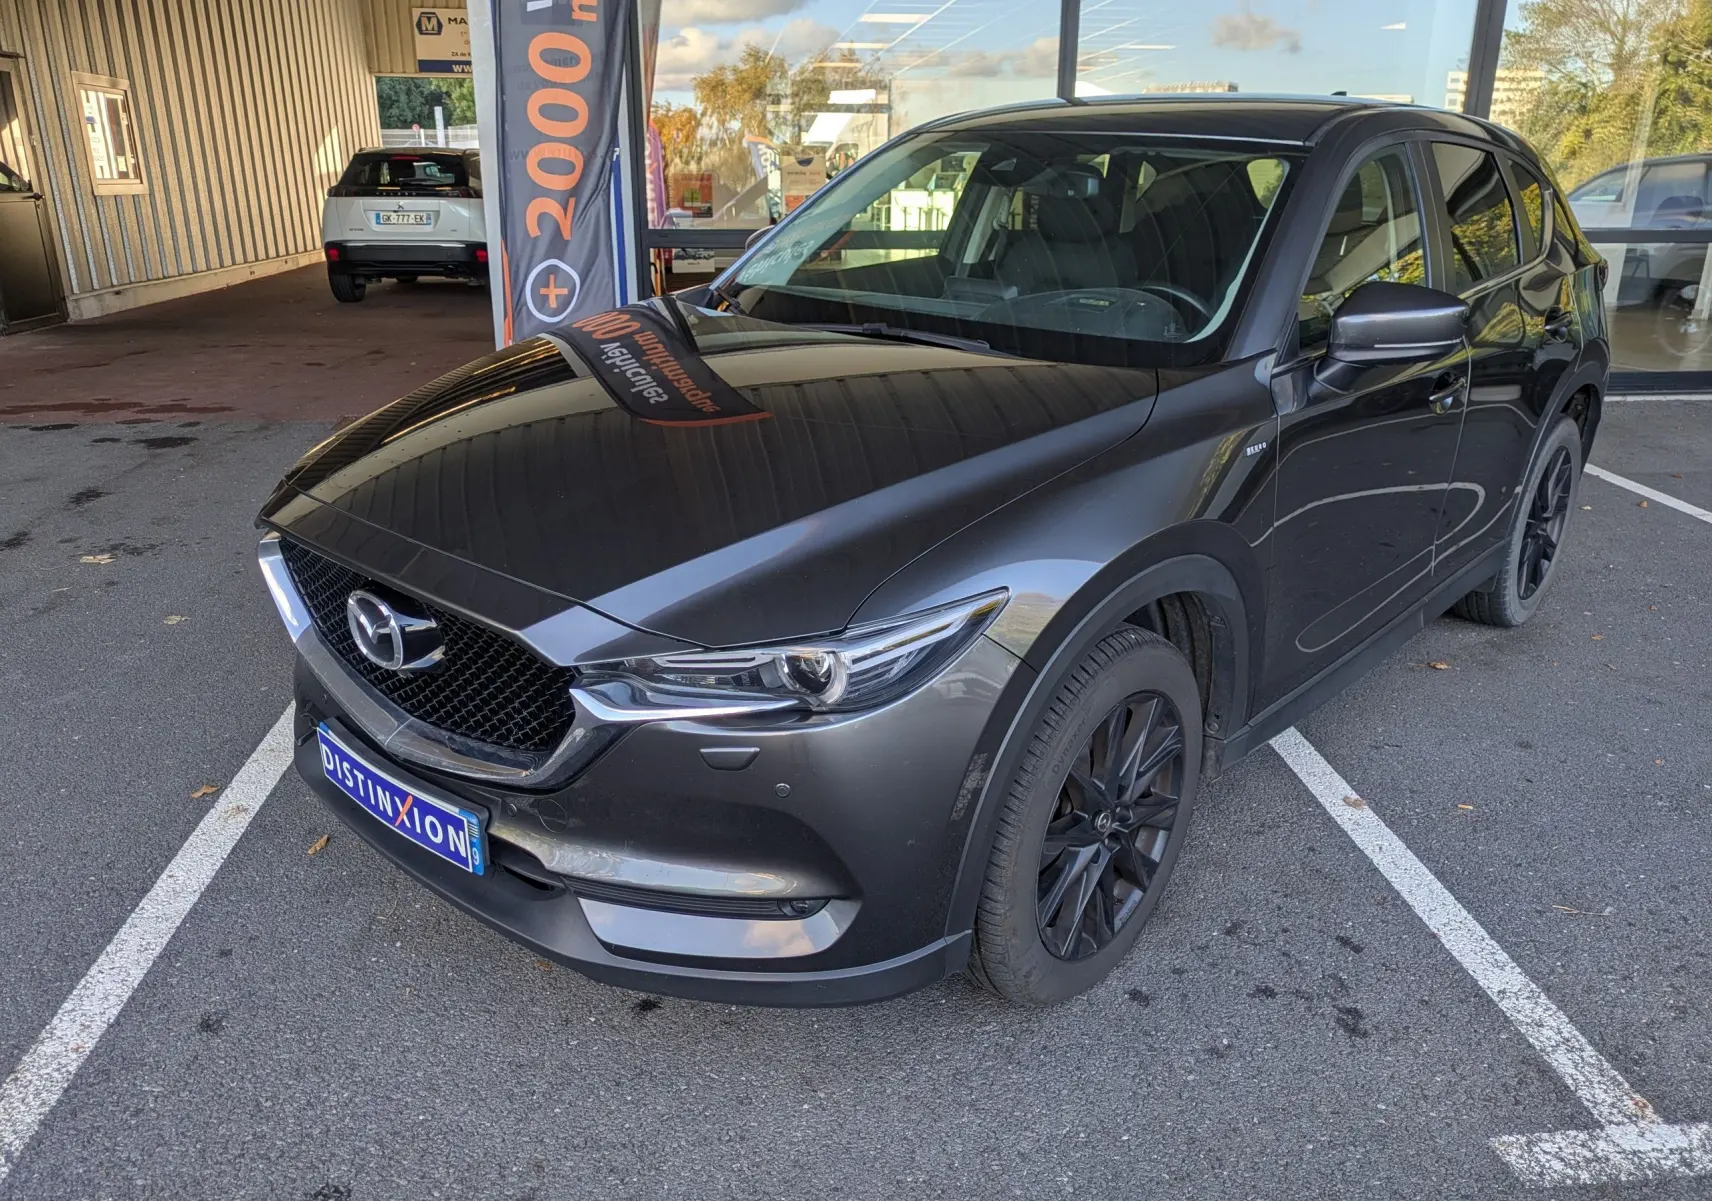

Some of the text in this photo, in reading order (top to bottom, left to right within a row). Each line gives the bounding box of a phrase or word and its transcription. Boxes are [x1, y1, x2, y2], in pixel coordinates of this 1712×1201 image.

[526, 32, 592, 240] 2000
[382, 214, 425, 223] GK-777-EK
[321, 742, 467, 859] DISTINXION
